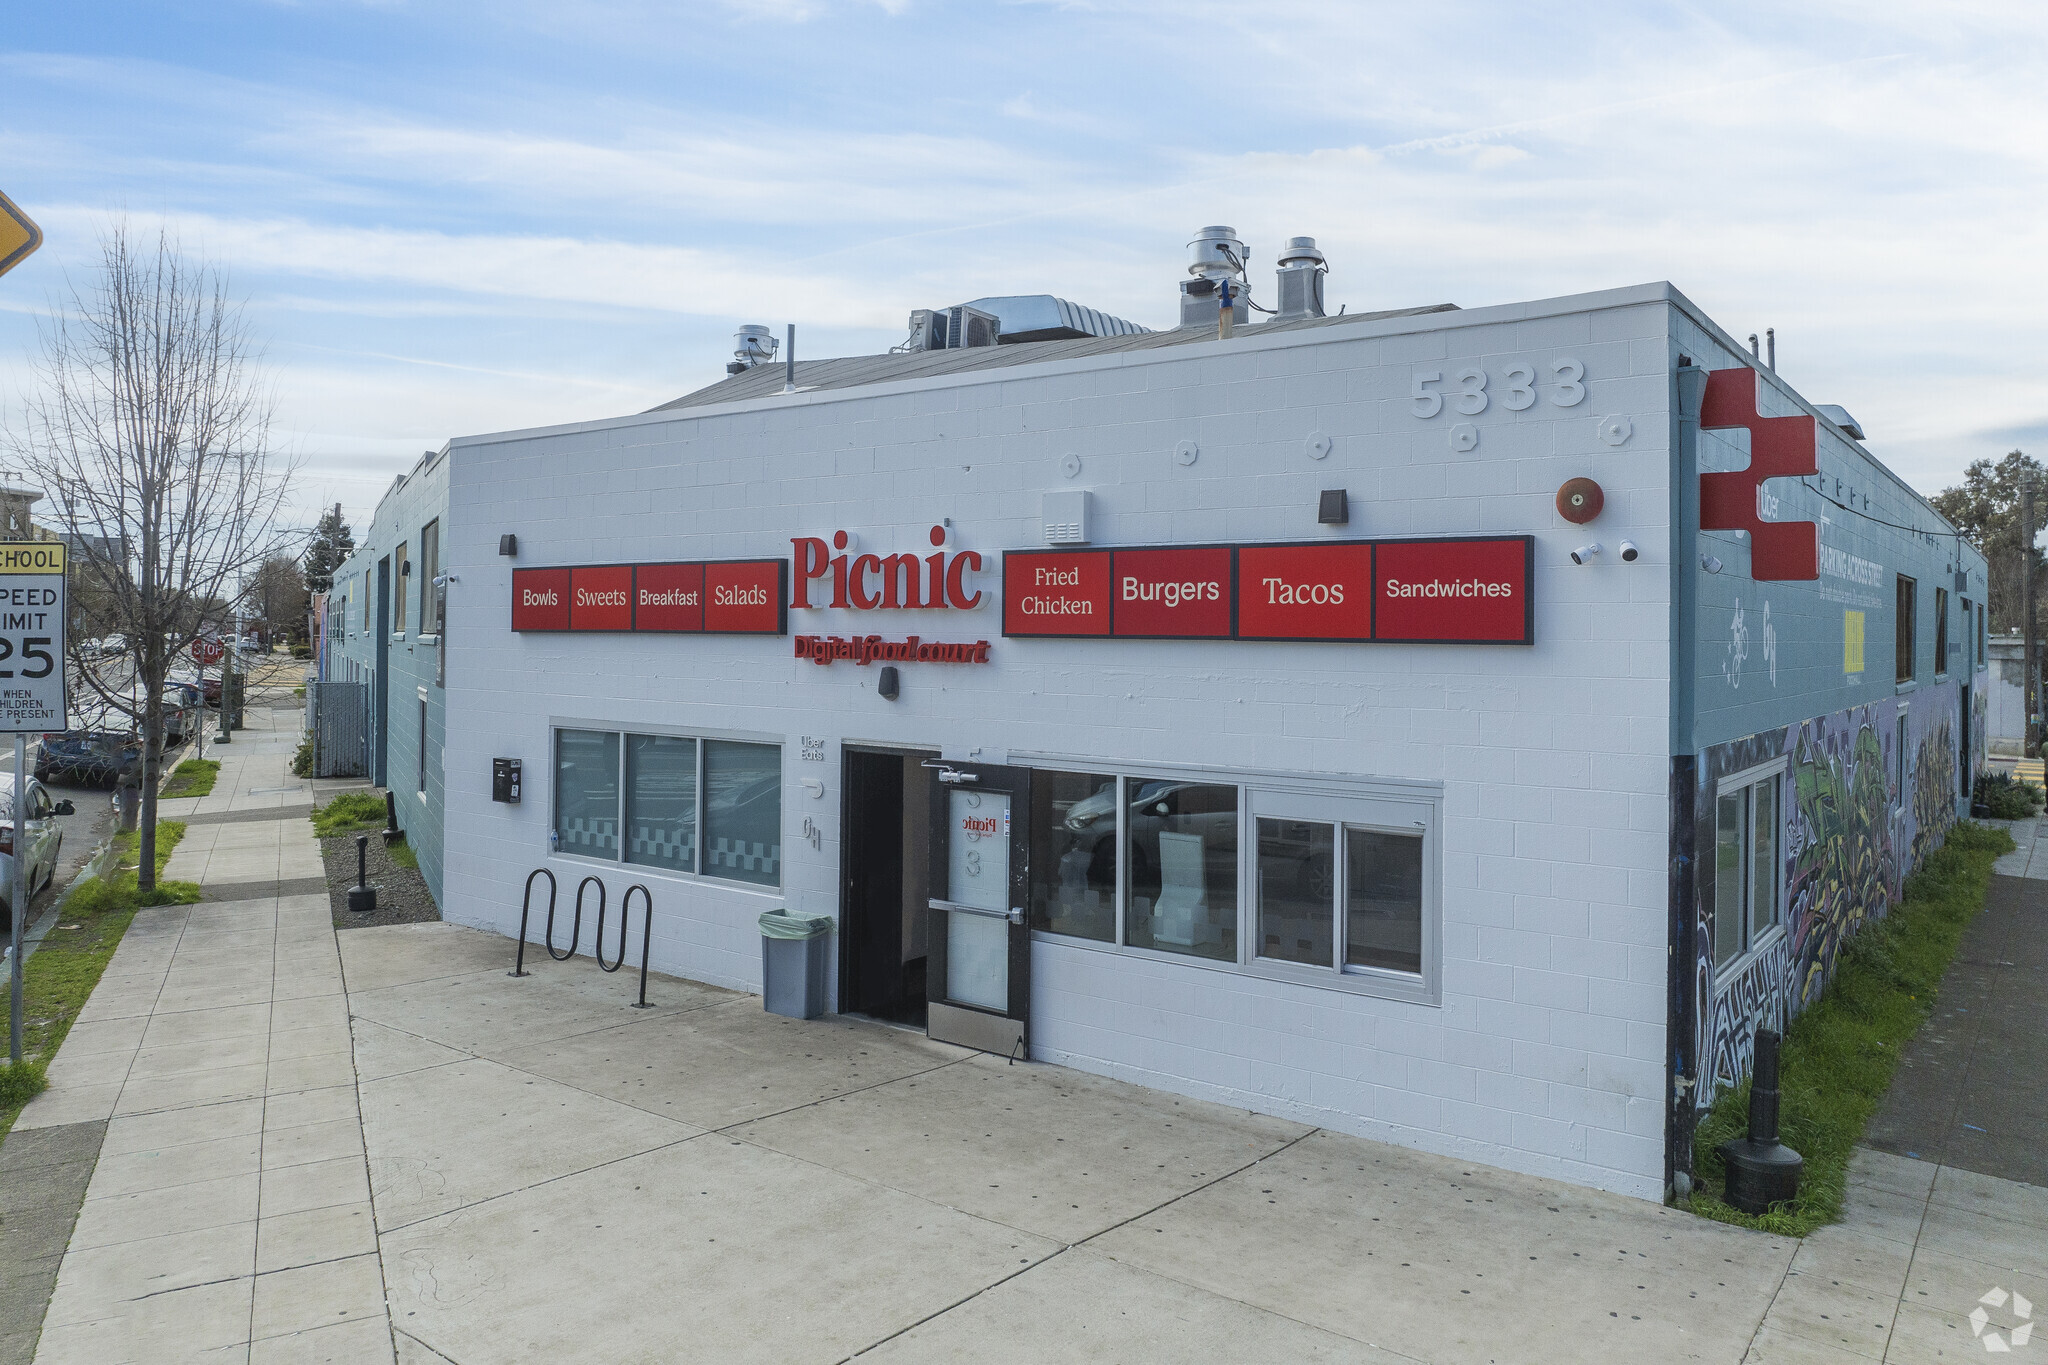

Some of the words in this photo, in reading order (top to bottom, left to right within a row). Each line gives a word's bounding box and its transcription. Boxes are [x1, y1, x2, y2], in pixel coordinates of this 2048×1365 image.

[1409, 357, 1587, 419] 5333
[0, 550, 60, 568] HOOL
[789, 525, 982, 610] Picnic
[1035, 567, 1079, 586] Fried
[523, 588, 558, 606] Bowls
[576, 588, 627, 607] Sweets
[639, 588, 698, 606] Breakfast
[714, 584, 767, 606] Salads
[1122, 576, 1220, 607] Burgers
[1262, 577, 1345, 605] Tacos
[1386, 578, 1512, 598] Sandwiches
[1021, 596, 1093, 615] Chicken
[794, 635, 863, 666] Digital
[856, 635, 919, 666] food
[917, 640, 992, 664] court
[3, 689, 32, 699] WHEN
[7, 709, 55, 719] PRESENT
[800, 735, 825, 748] Uber
[801, 748, 824, 761] Eats
